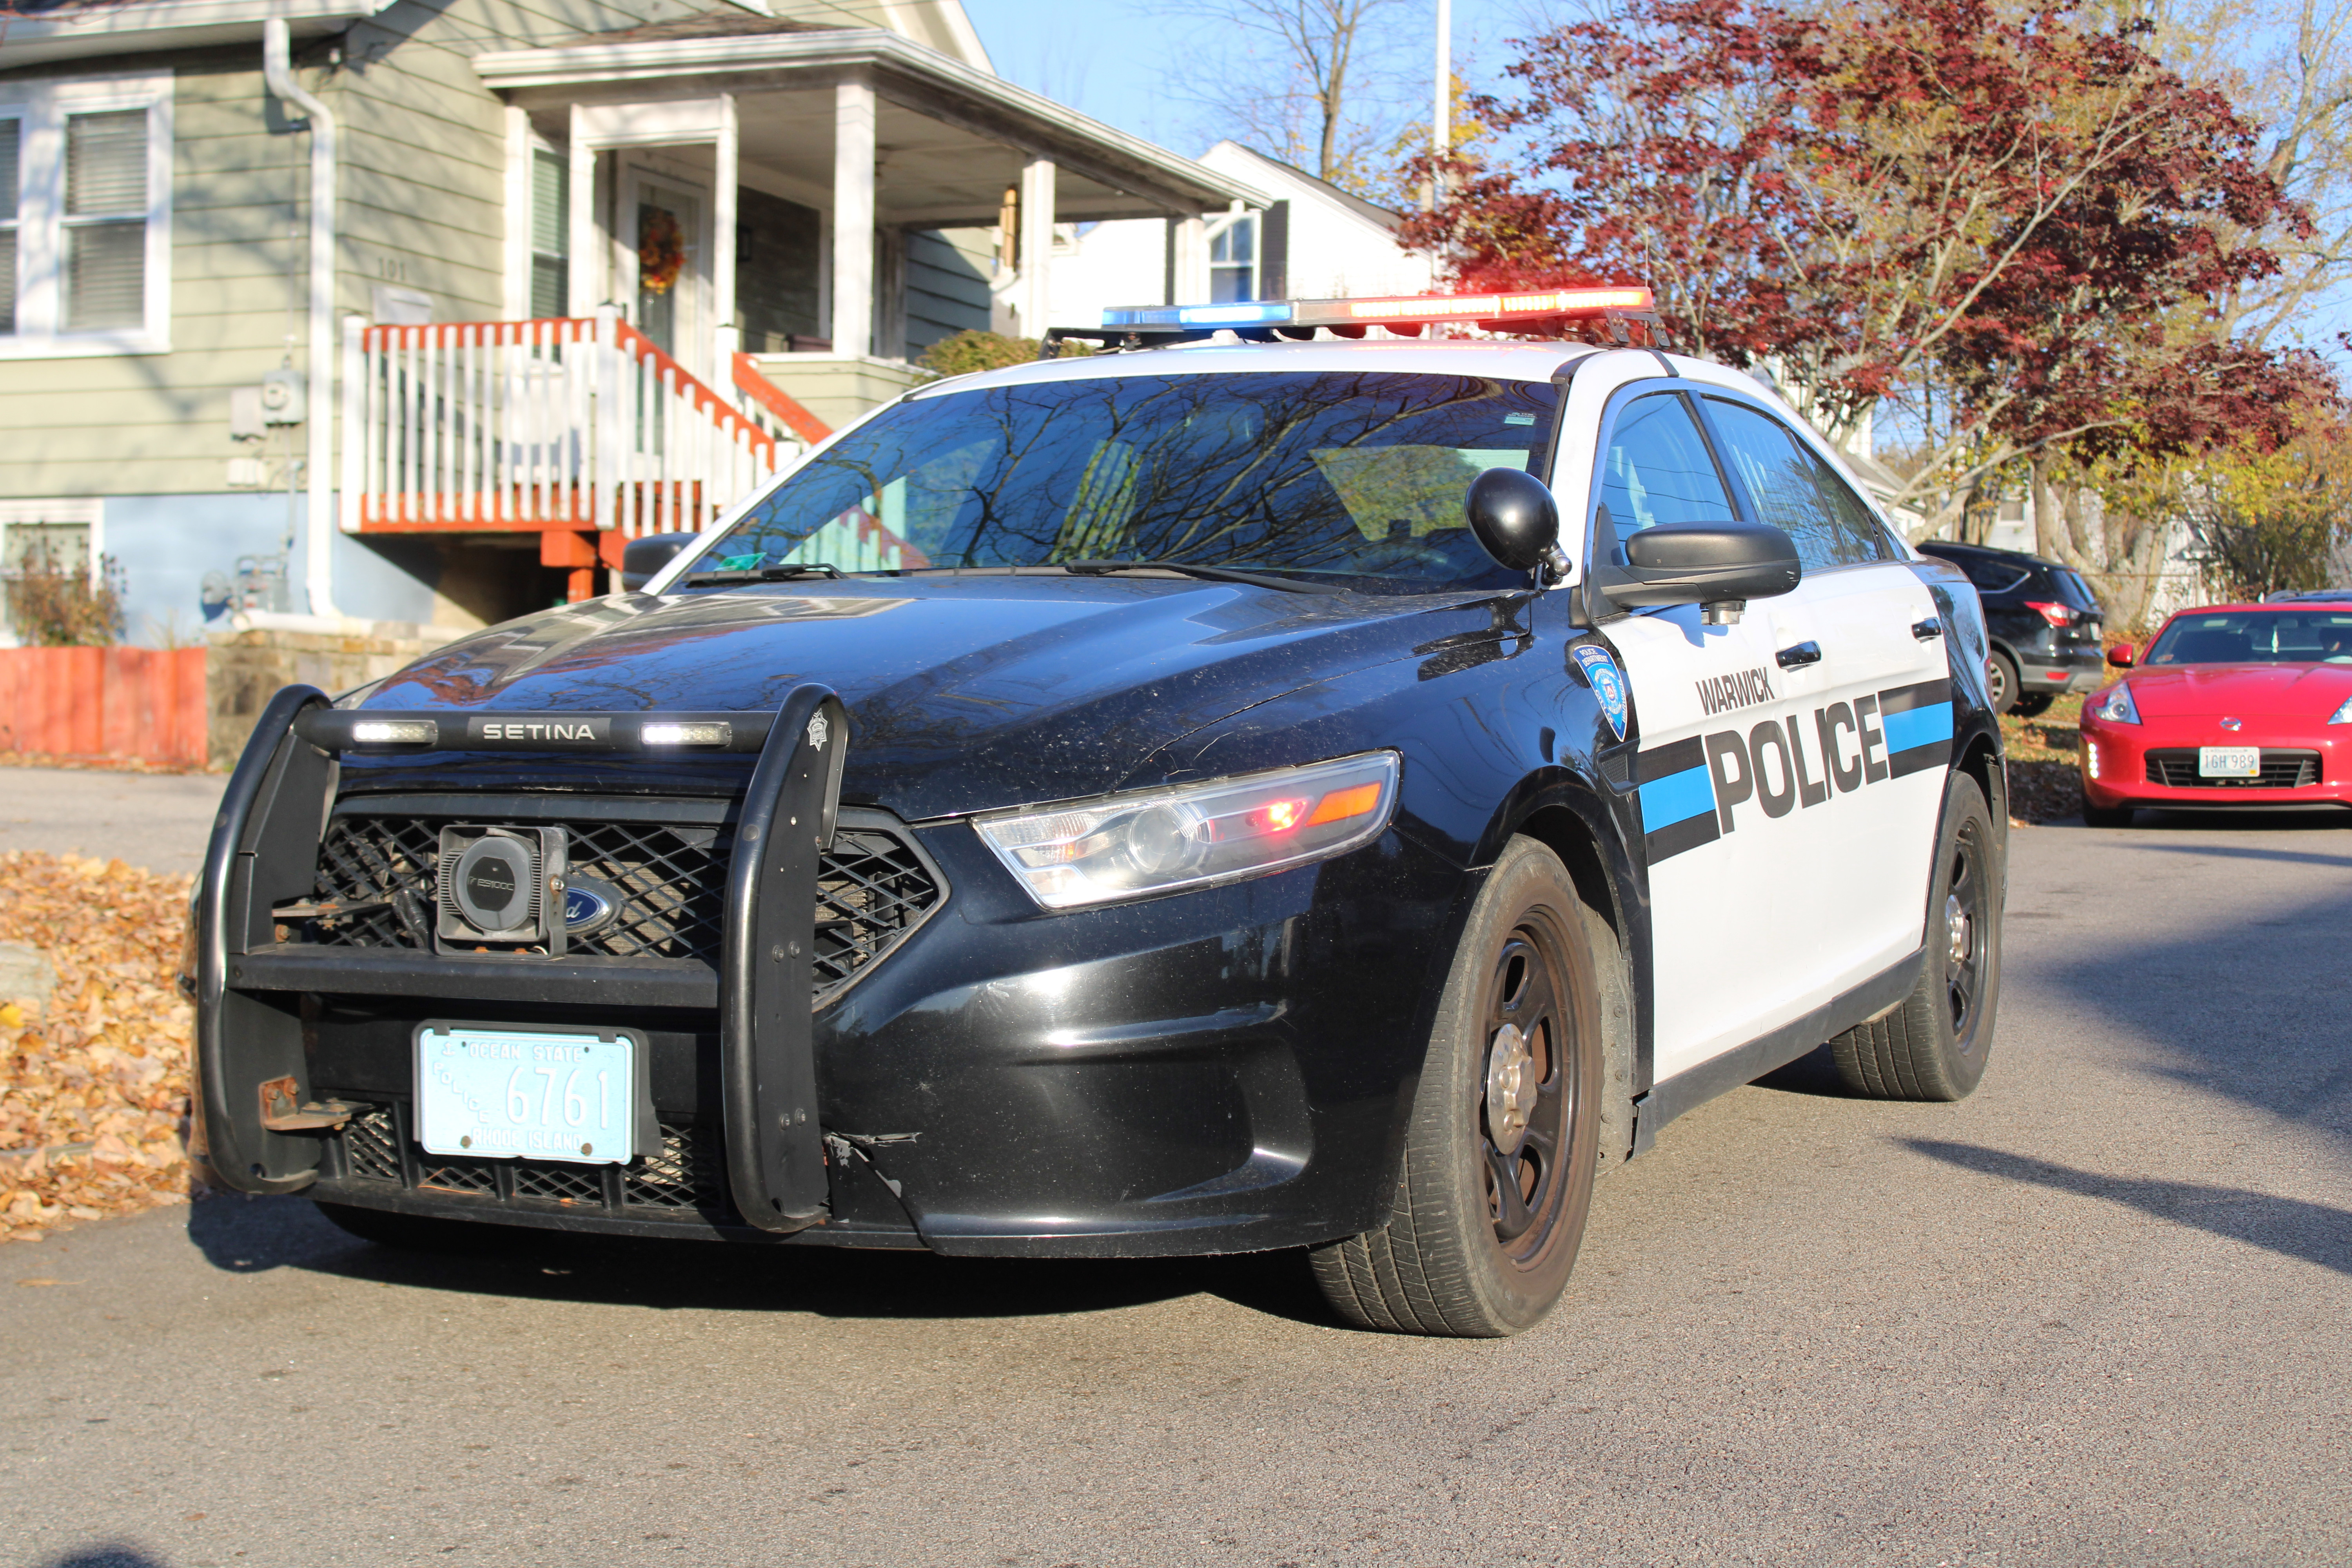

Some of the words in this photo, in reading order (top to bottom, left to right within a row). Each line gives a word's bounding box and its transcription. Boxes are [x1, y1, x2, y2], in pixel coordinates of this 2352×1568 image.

[379, 257, 406, 281] 101
[1579, 648, 1598, 657] POLICE
[1582, 655, 1609, 667] DEPARTMENT
[1618, 679, 1626, 723] WARWICK
[1695, 667, 1775, 716] WARWICK
[1595, 689, 1607, 710] CITY
[1607, 713, 1614, 724] OF
[483, 724, 596, 740] SETINA
[1705, 694, 1889, 835] POLICE
[2232, 755, 2255, 768] 989
[477, 878, 514, 891] ES100C
[469, 1042, 521, 1059] OCEAN
[534, 1045, 582, 1062] STATE
[433, 1062, 490, 1123] POLICE
[506, 1066, 608, 1129] 6761
[472, 1128, 521, 1147] RHODE
[528, 1131, 582, 1152] ISLAND
